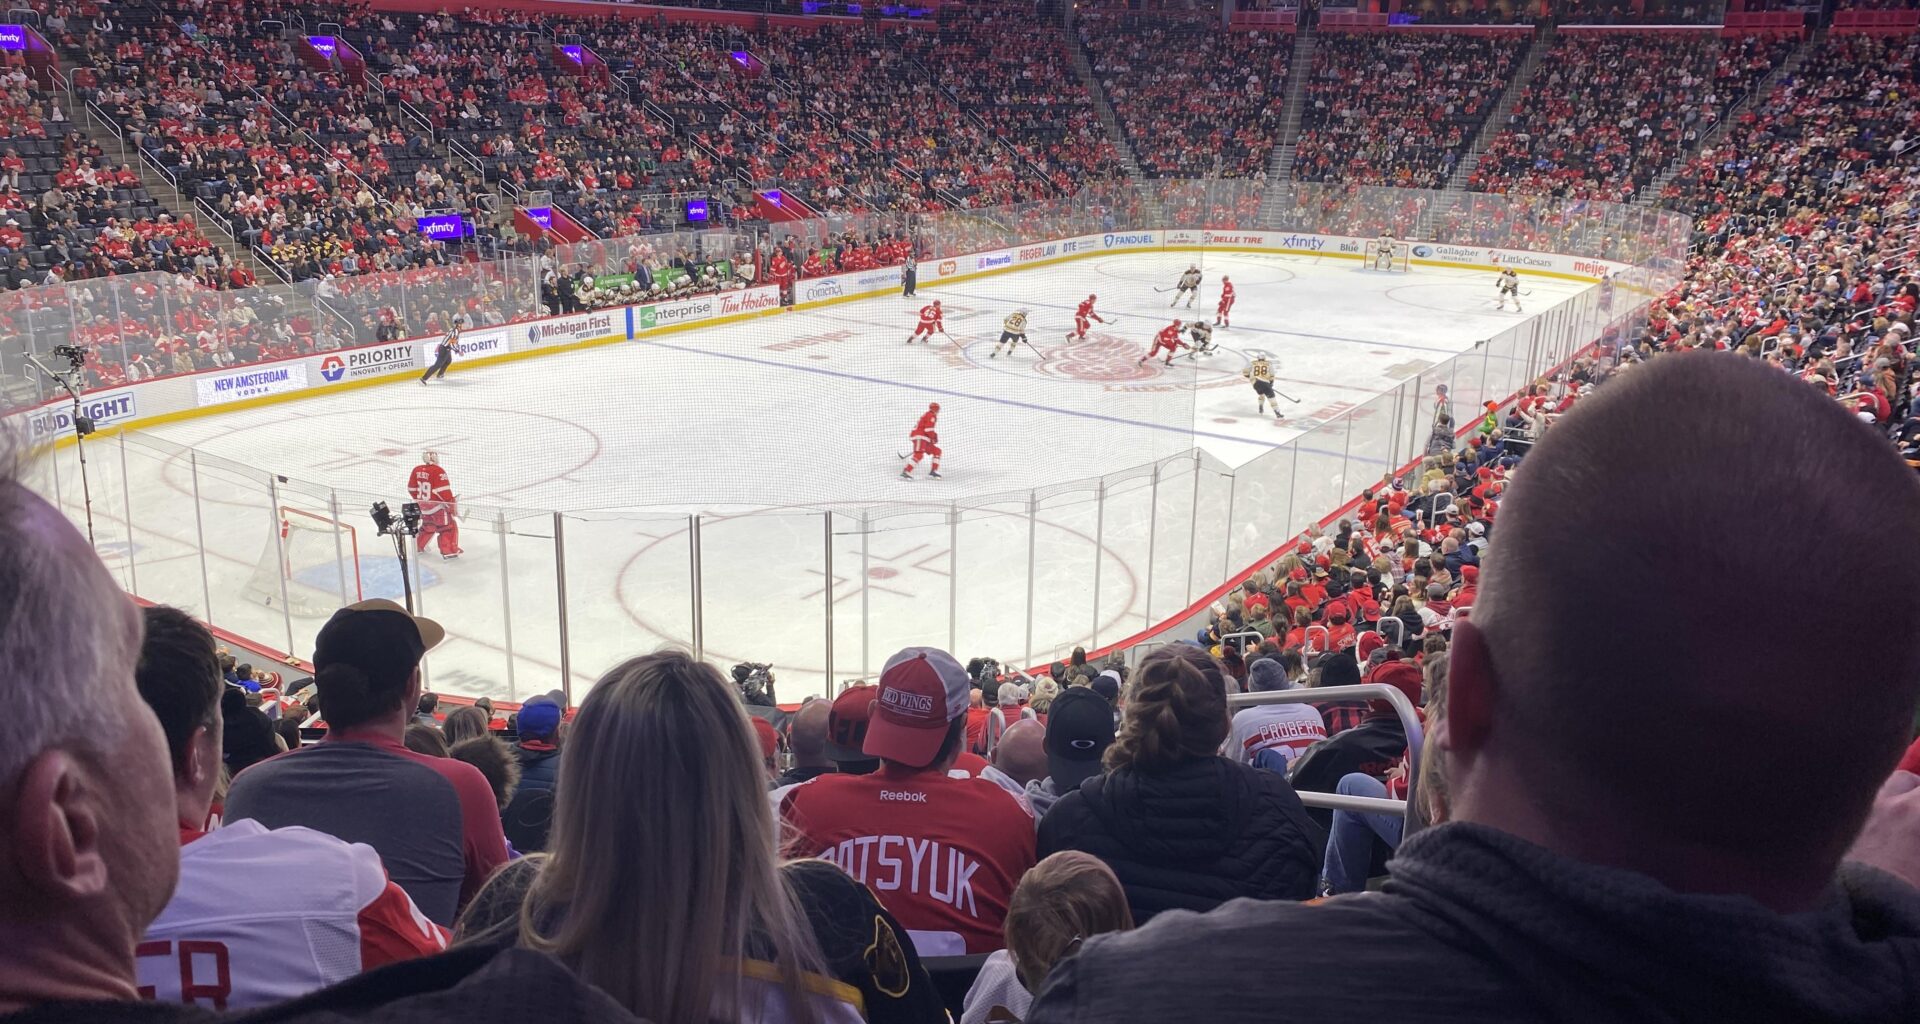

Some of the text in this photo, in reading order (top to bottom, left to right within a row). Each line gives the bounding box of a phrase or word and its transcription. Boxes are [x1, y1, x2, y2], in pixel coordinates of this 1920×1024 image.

[1115, 234, 1154, 245] FANDUEL
[1283, 235, 1325, 250] xfinity
[1063, 242, 1077, 253] DTE
[1340, 243, 1359, 253] Blue
[1436, 246, 1479, 257] Gallagher
[986, 255, 1011, 266] Rewards
[1574, 260, 1609, 277] meijer
[720, 292, 779, 314] Tim Hortons
[641, 304, 711, 325] enterprise
[541, 315, 611, 337] Michigan First
[576, 330, 595, 339] CREDIT
[350, 345, 413, 367] PRIORITY
[350, 361, 414, 377] INNOVATE OPERATE
[1253, 365, 1268, 377] 88
[214, 368, 289, 392] NEW AMSTERDAM
[237, 386, 269, 397] VODKA
[33, 397, 131, 436] BUD IGHT
[882, 687, 899, 704] RED
[900, 692, 933, 711] WINGS
[1258, 719, 1321, 744] PROBERT
[880, 789, 927, 803] Reebok
